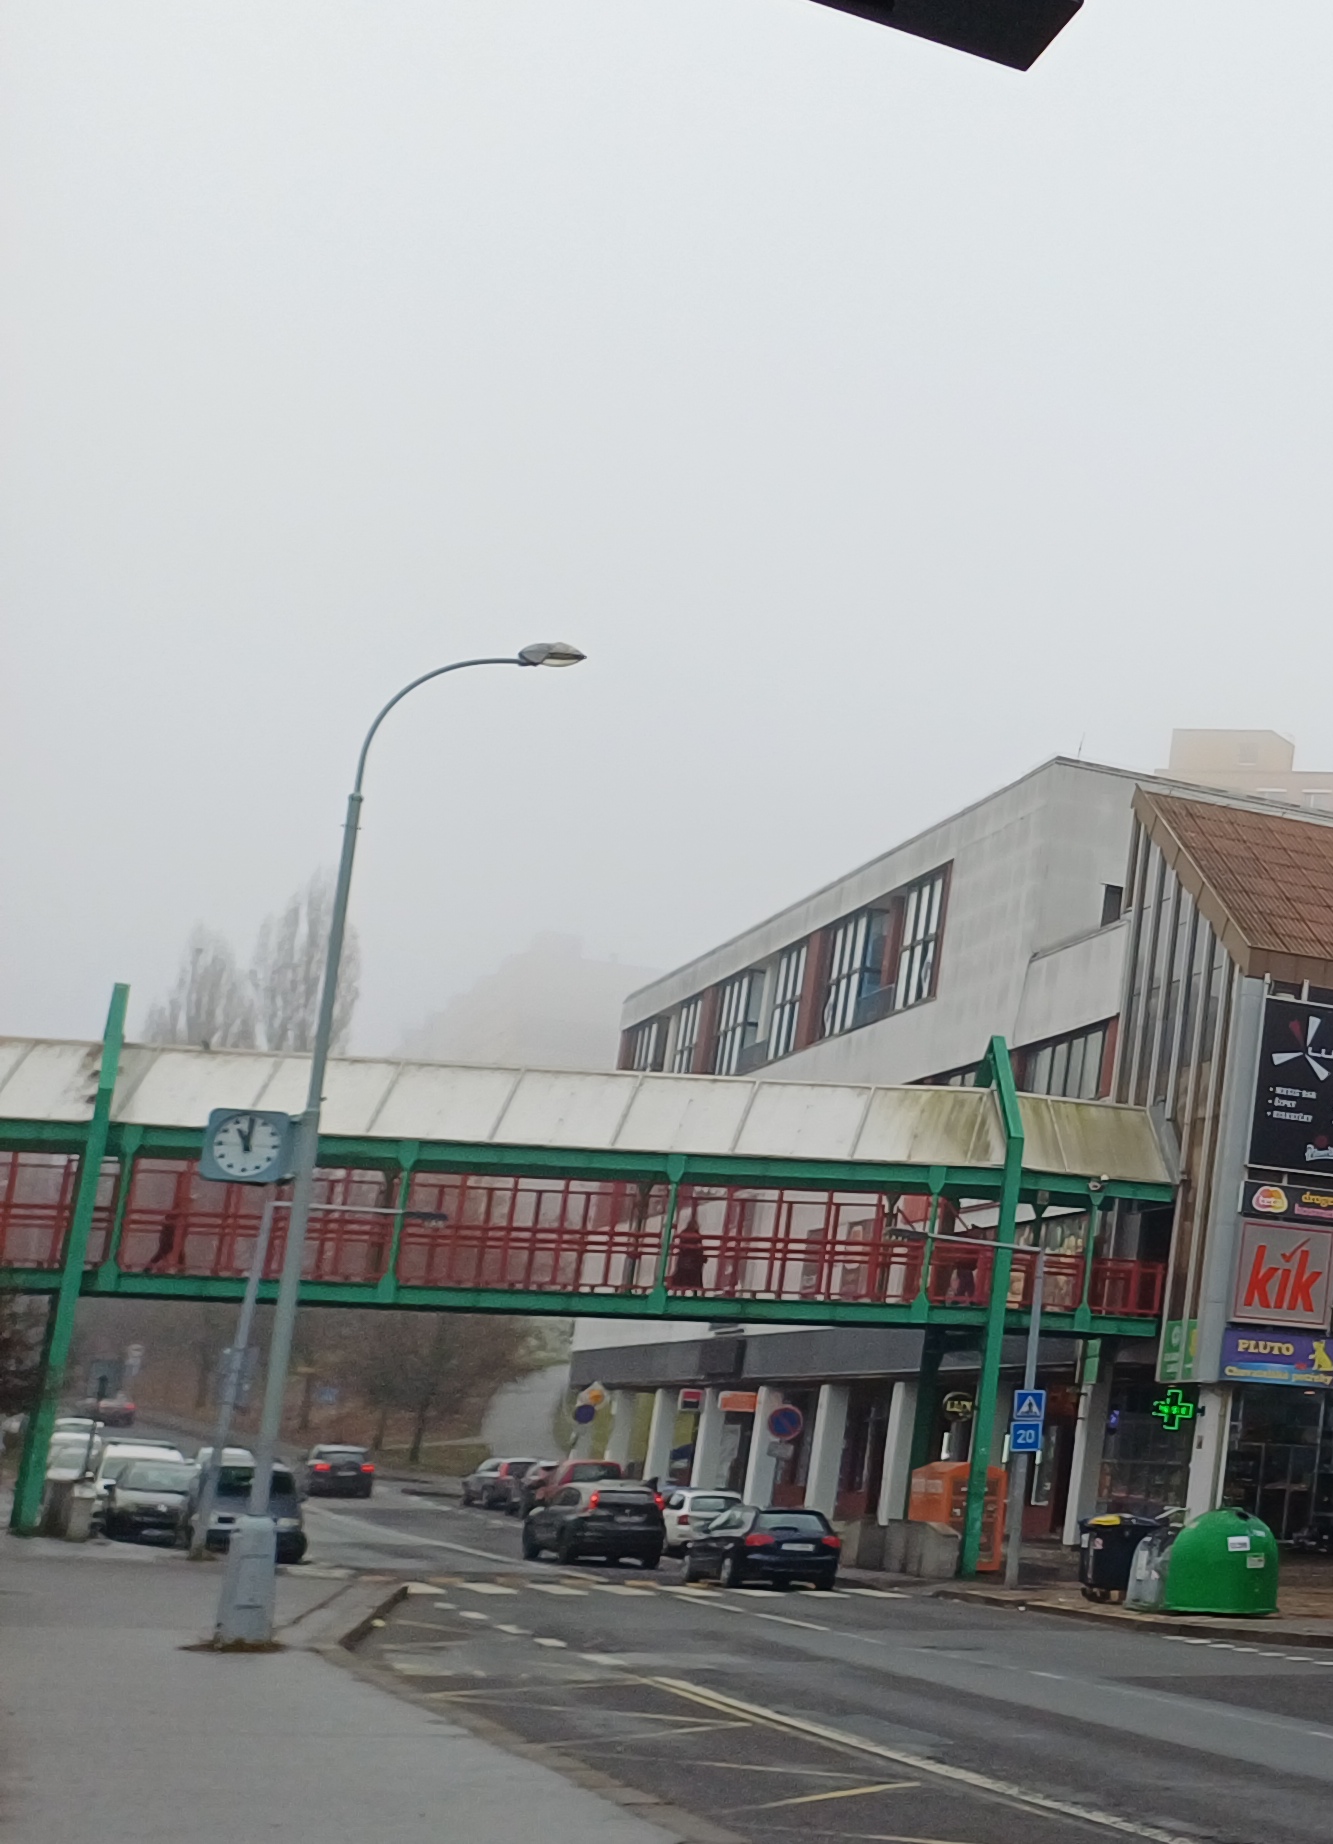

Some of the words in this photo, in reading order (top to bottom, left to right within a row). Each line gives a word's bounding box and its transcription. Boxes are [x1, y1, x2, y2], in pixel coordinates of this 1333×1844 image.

[1243, 1243, 1322, 1314] kik
[1237, 1339, 1295, 1356] PLUTO
[1016, 1429, 1036, 1444] 20
